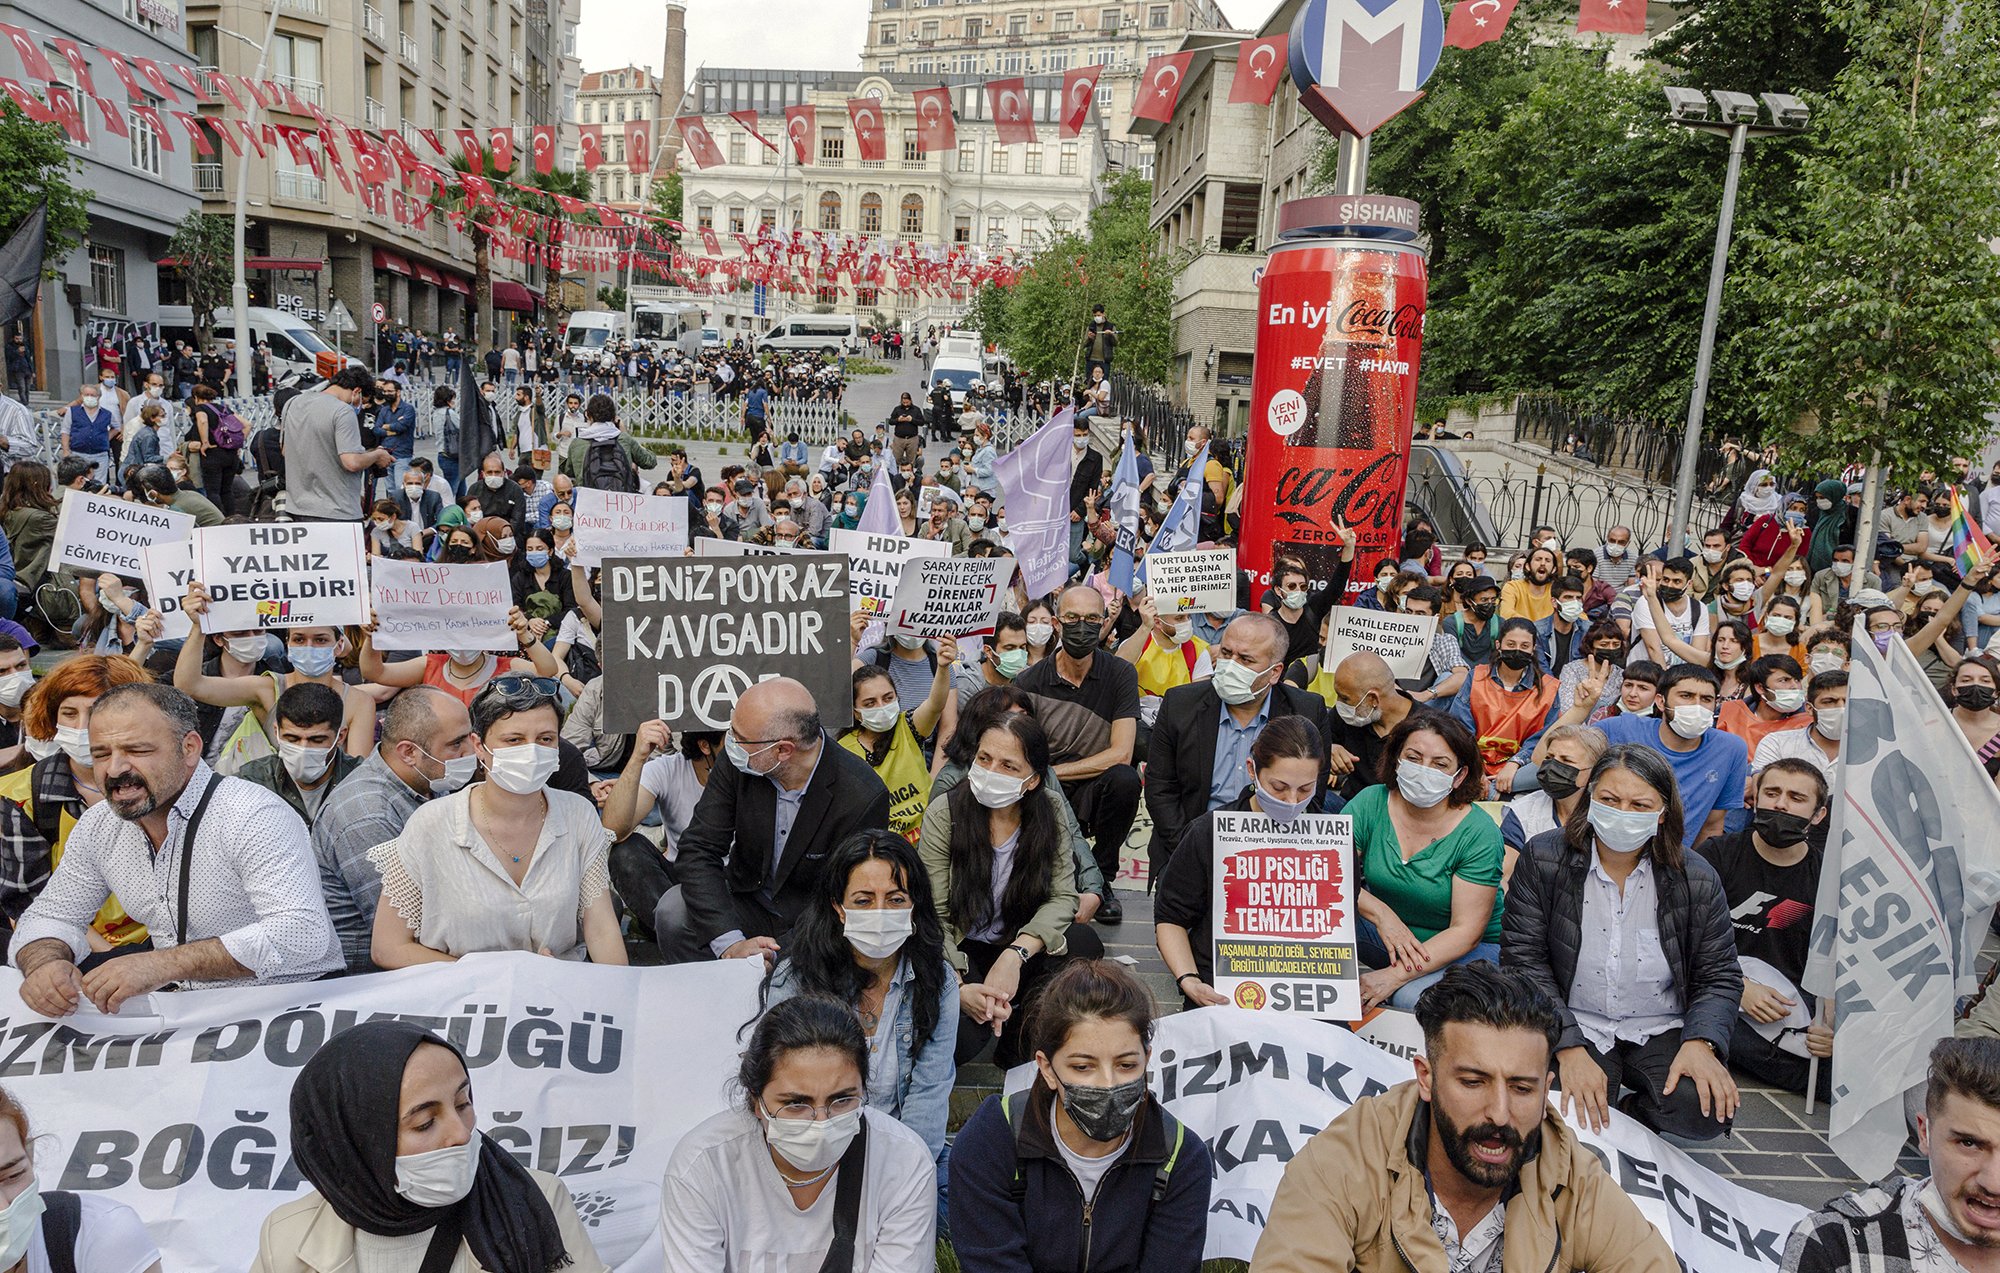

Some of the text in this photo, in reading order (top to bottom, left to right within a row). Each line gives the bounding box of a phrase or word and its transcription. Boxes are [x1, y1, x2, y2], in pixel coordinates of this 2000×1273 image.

[1339, 200, 1414, 225] ŞİŞHANE
[277, 294, 303, 307] BIG
[1269, 303, 1295, 325] En
[1302, 301, 1332, 329] iyi
[1291, 356, 1409, 376] #EVET #HAYIR
[1272, 395, 1301, 415] YENİ
[1275, 410, 1298, 426] TAT
[606, 494, 645, 514] HDP
[86, 501, 170, 529] BASKILARA
[576, 513, 612, 529] YALNIZ
[96, 527, 152, 547] BOYUN
[250, 527, 308, 545] HDP
[867, 536, 910, 554] HDP
[1292, 529, 1337, 542] ZERO
[64, 544, 141, 571] EĞMEYEC
[223, 553, 329, 574] YALNIZ
[922, 560, 996, 573] SARAY REJİMİ
[1152, 553, 1229, 565] KURTULUŞ YOK
[411, 566, 450, 584] HDP
[921, 572, 993, 585] YENİLECEK
[1161, 564, 1221, 574] TEK BAŞINA
[1189, 573, 1231, 582] BERABER
[211, 576, 355, 602] DEĞİLDİR!
[720, 563, 844, 605] POYRAZ
[927, 586, 985, 600] DİRENEN
[1171, 584, 1187, 593] HİÇ
[1190, 582, 1231, 592] BİRİMİZ!
[376, 585, 431, 604] YALNIZ
[259, 602, 314, 626] Kaldıraç
[924, 601, 983, 613] HALKLAR
[908, 612, 990, 625] KAZANACAK!
[1348, 616, 1420, 633] KATİLLERDEN
[626, 610, 825, 661] KAVGADIR
[1337, 627, 1425, 647] HESABI GENÇLİK
[1217, 817, 1350, 836] NE ARARSAN VAR!
[1236, 856, 1261, 880] BU
[1248, 882, 1317, 907] DEVRİM
[1235, 908, 1332, 933] TEMİZLER!
[1218, 943, 1353, 960] YAŞANANLAR DİZİ DEĞİL, SEYRETME!
[1230, 958, 1341, 975] ÖRGÜTLÜ MÜCADELEYE KATIL!
[1269, 982, 1338, 1013] SEP
